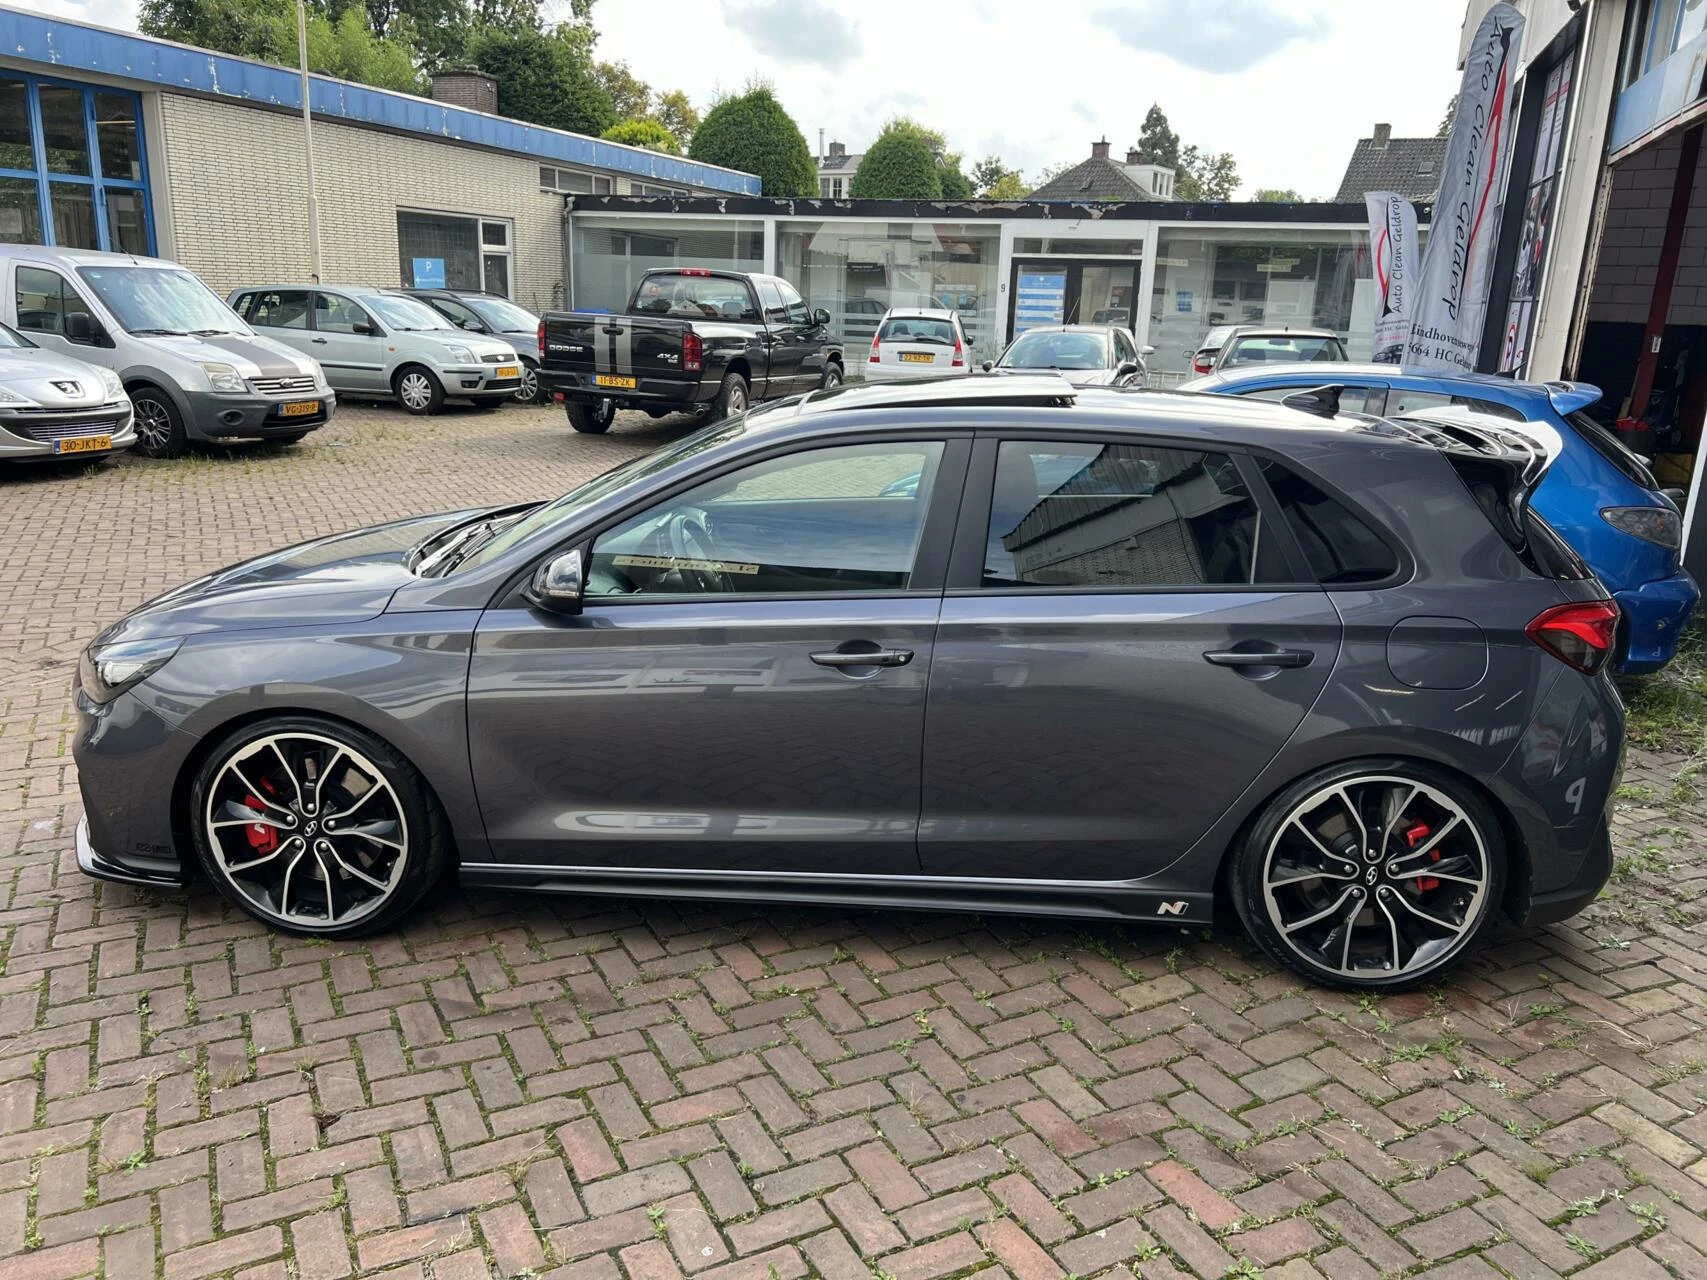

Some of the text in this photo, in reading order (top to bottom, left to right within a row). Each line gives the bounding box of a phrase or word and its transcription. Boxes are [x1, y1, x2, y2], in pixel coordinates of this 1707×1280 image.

[1442, 15, 1502, 321] Auto Clean Geldrop
[1390, 196, 1403, 314] Auto Clean Geldrop
[425, 260, 433, 273] P
[1000, 283, 1006, 293] 9
[549, 344, 583, 353] DODGE
[1434, 346, 1452, 363] HC
[600, 375, 632, 387] 11-BS-ZK
[62, 438, 109, 452] 30-JKT-6
